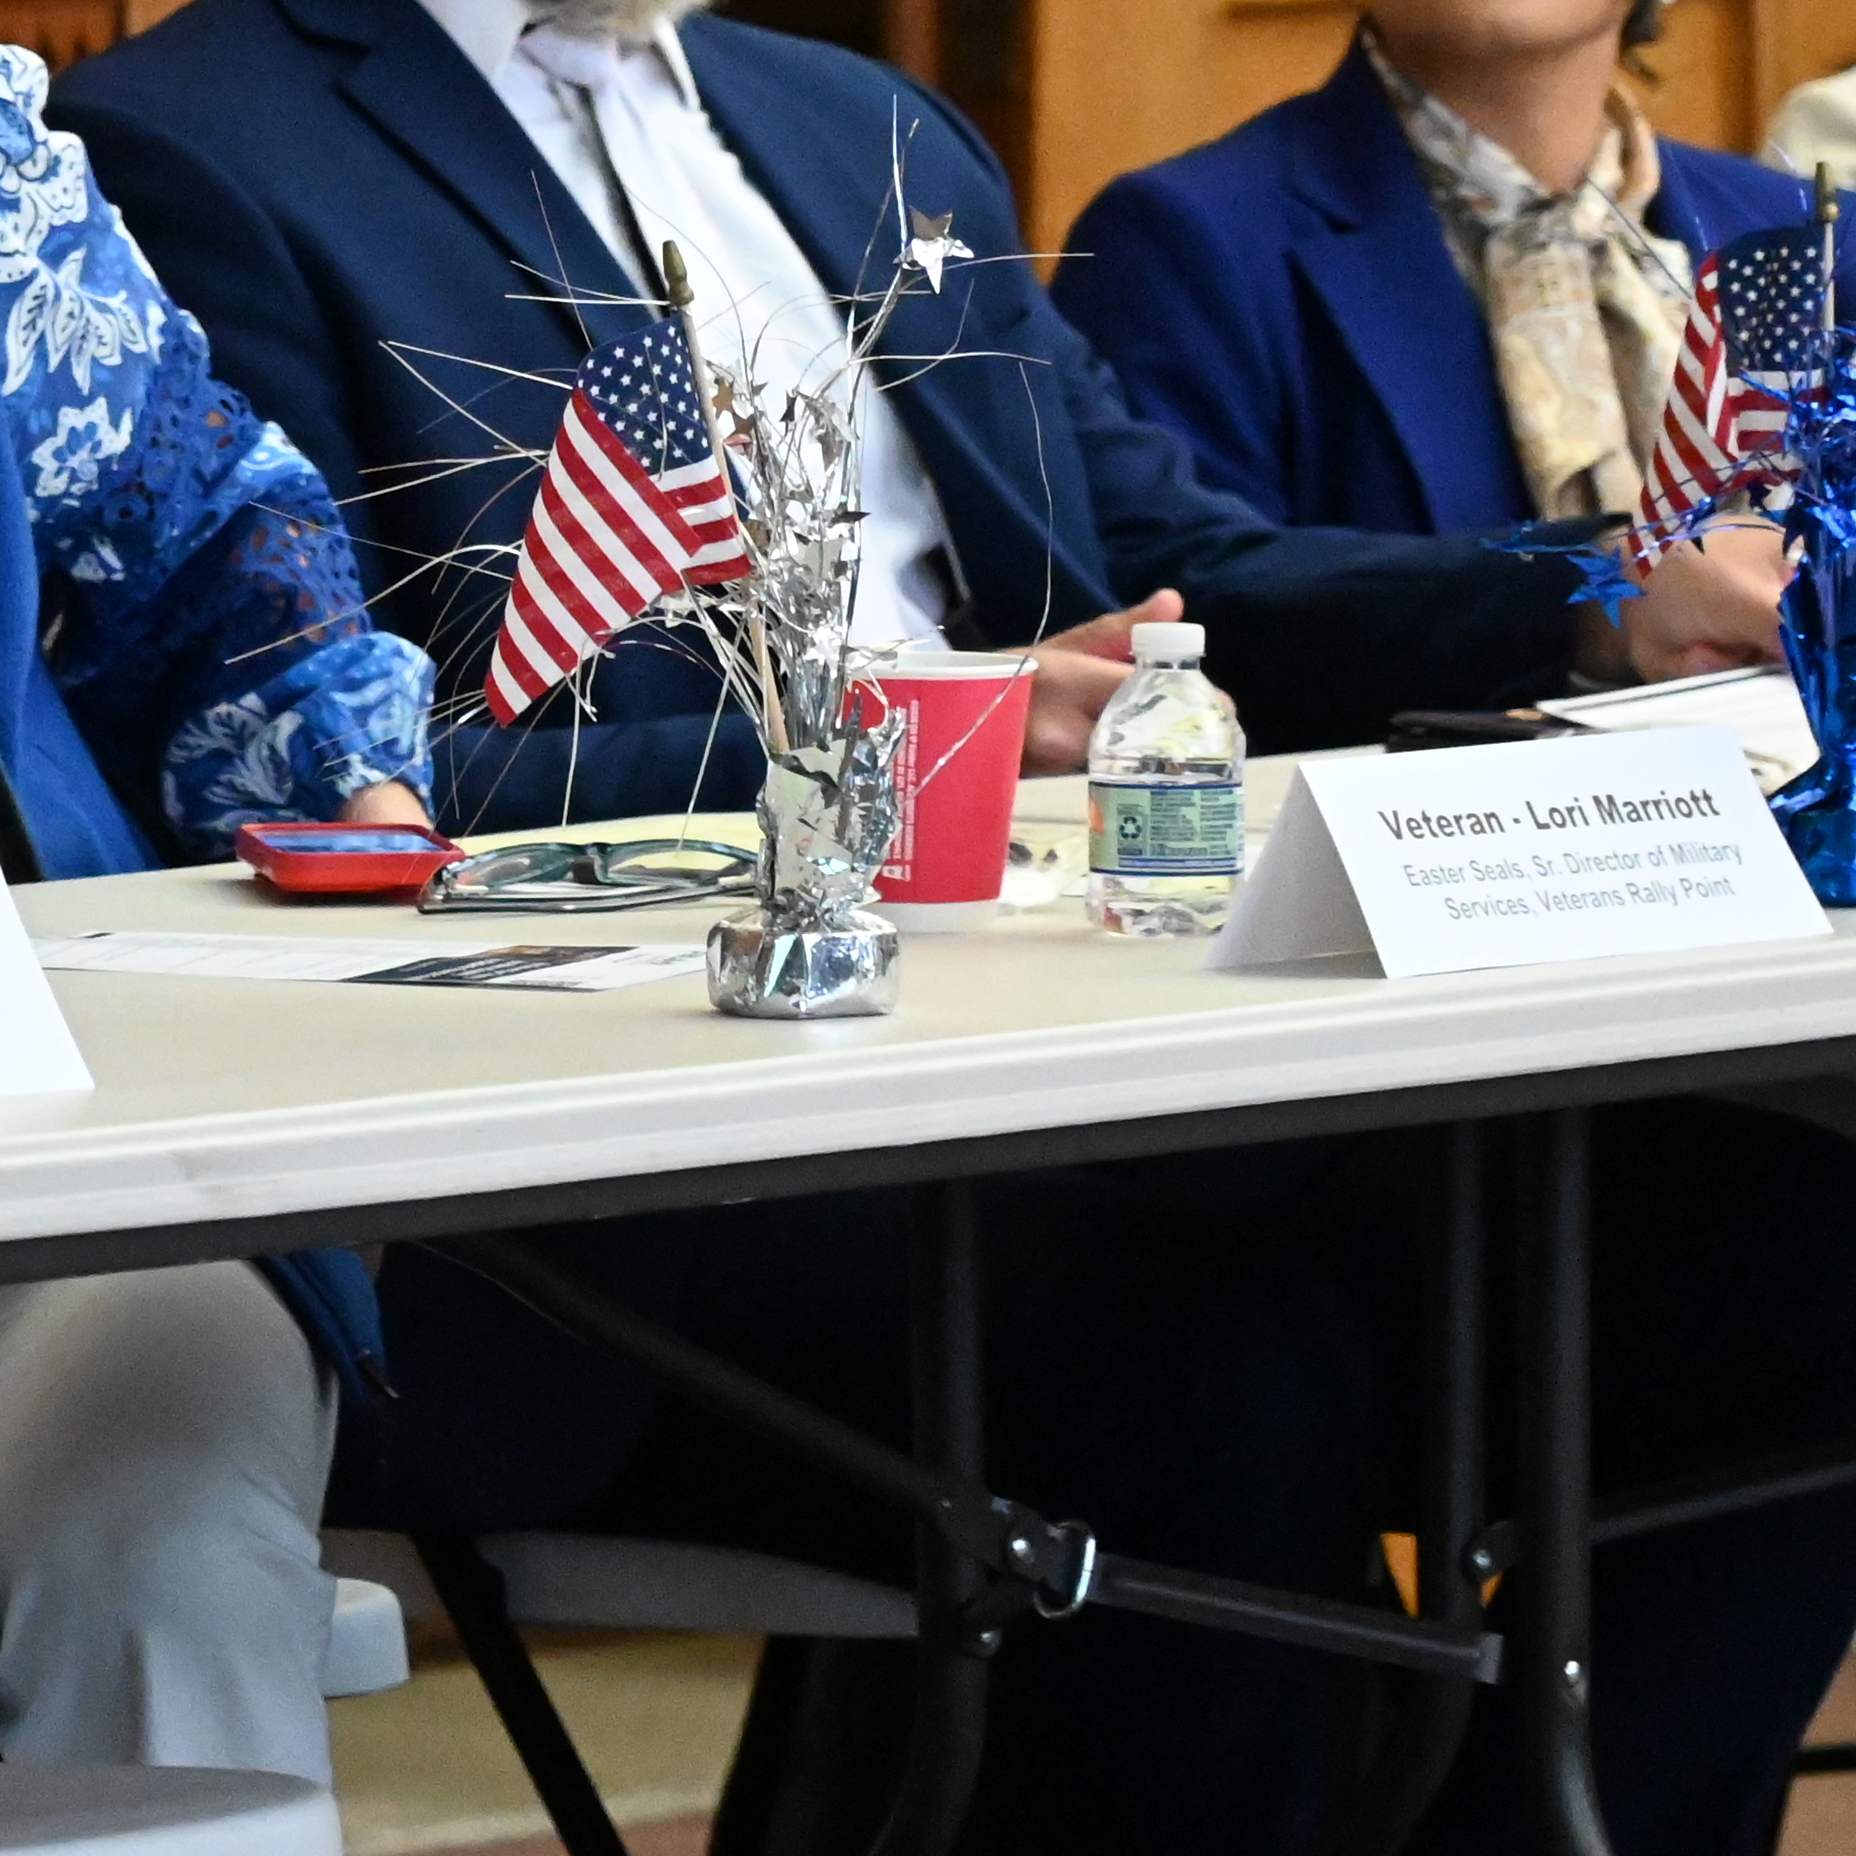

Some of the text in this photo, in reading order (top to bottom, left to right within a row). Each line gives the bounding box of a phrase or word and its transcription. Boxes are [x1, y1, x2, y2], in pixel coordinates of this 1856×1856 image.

[1378, 809, 1506, 841] Veteran
[1524, 797, 1590, 831] Lori
[1592, 788, 1721, 826] Marriott
[1402, 841, 1744, 888] Easter Seals, Sr. Director of Military
[1443, 873, 1736, 921] Services, Veterans Rally Point
